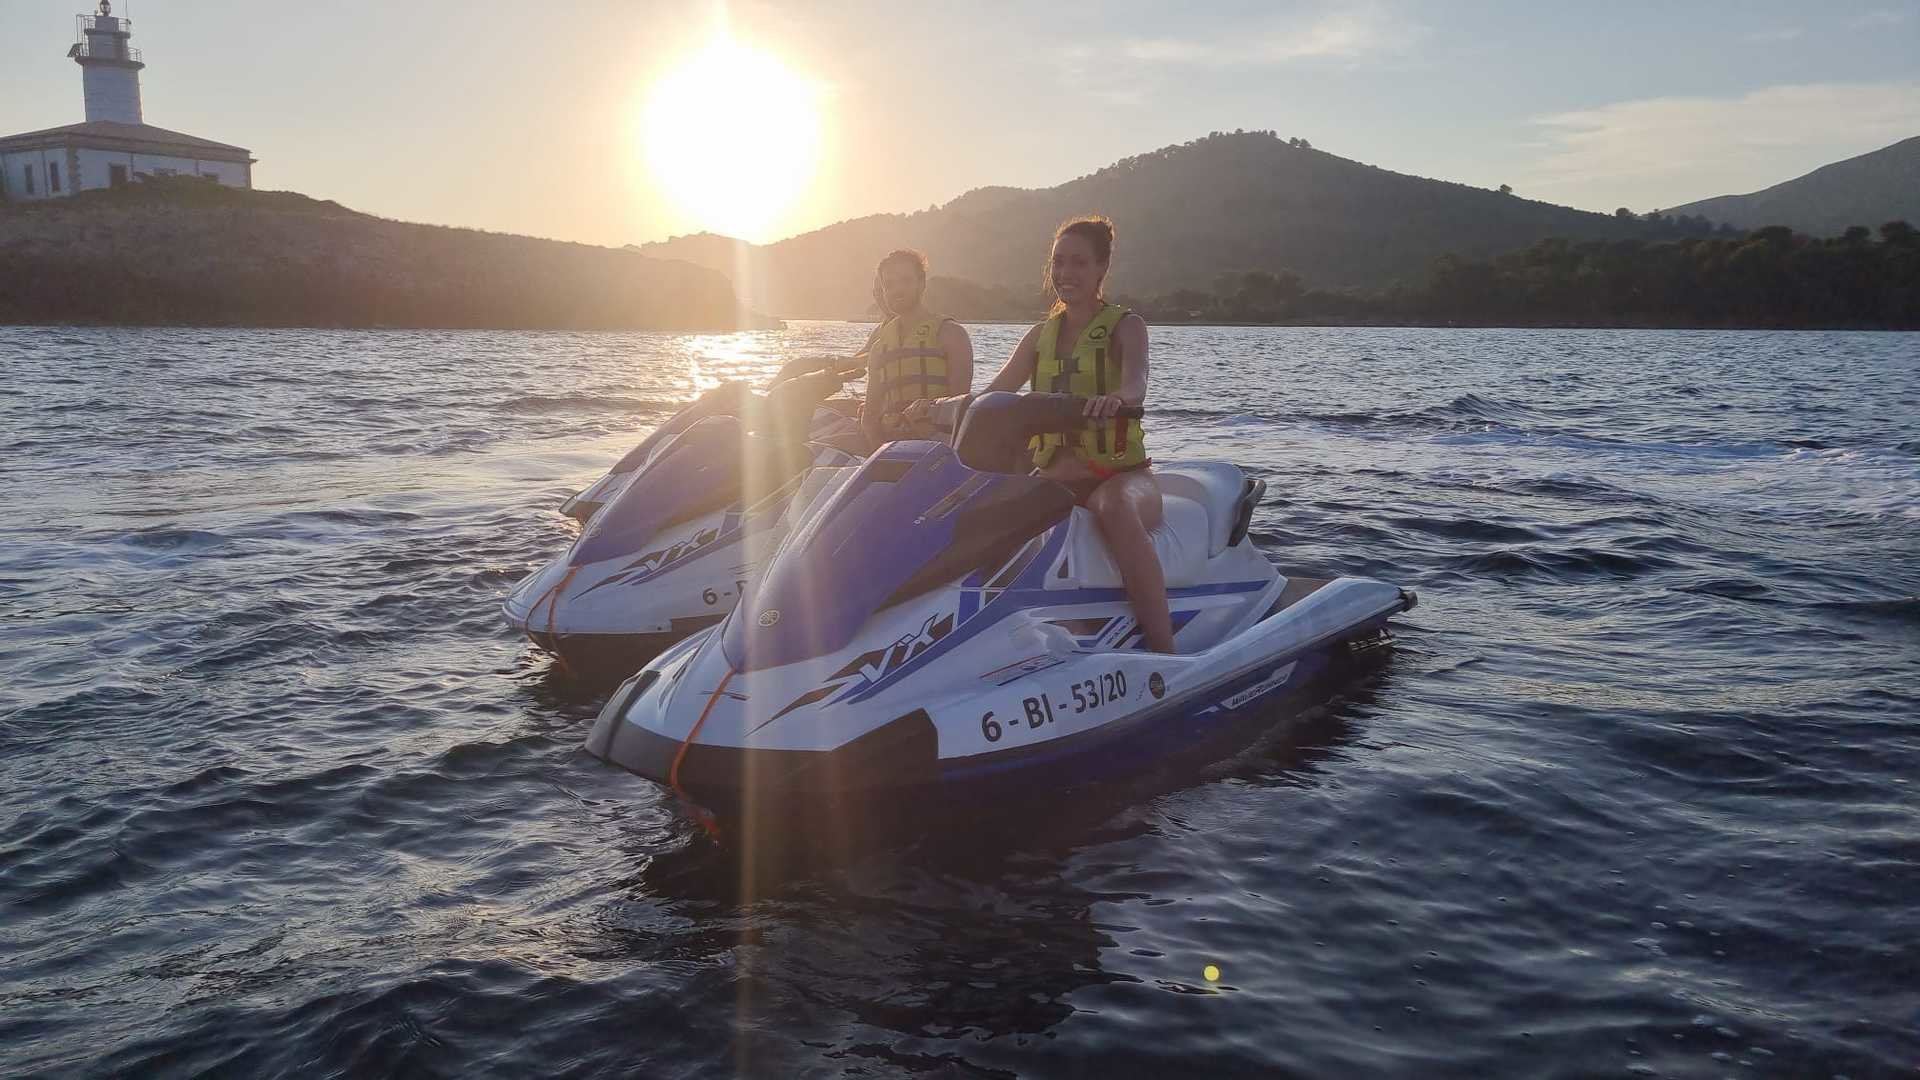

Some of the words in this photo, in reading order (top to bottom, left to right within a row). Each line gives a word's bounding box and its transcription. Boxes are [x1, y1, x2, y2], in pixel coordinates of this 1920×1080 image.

[702, 588, 718, 605] 6
[981, 711, 1002, 742] 6
[1023, 693, 1054, 729] BI
[1071, 670, 1126, 713] 53/20
